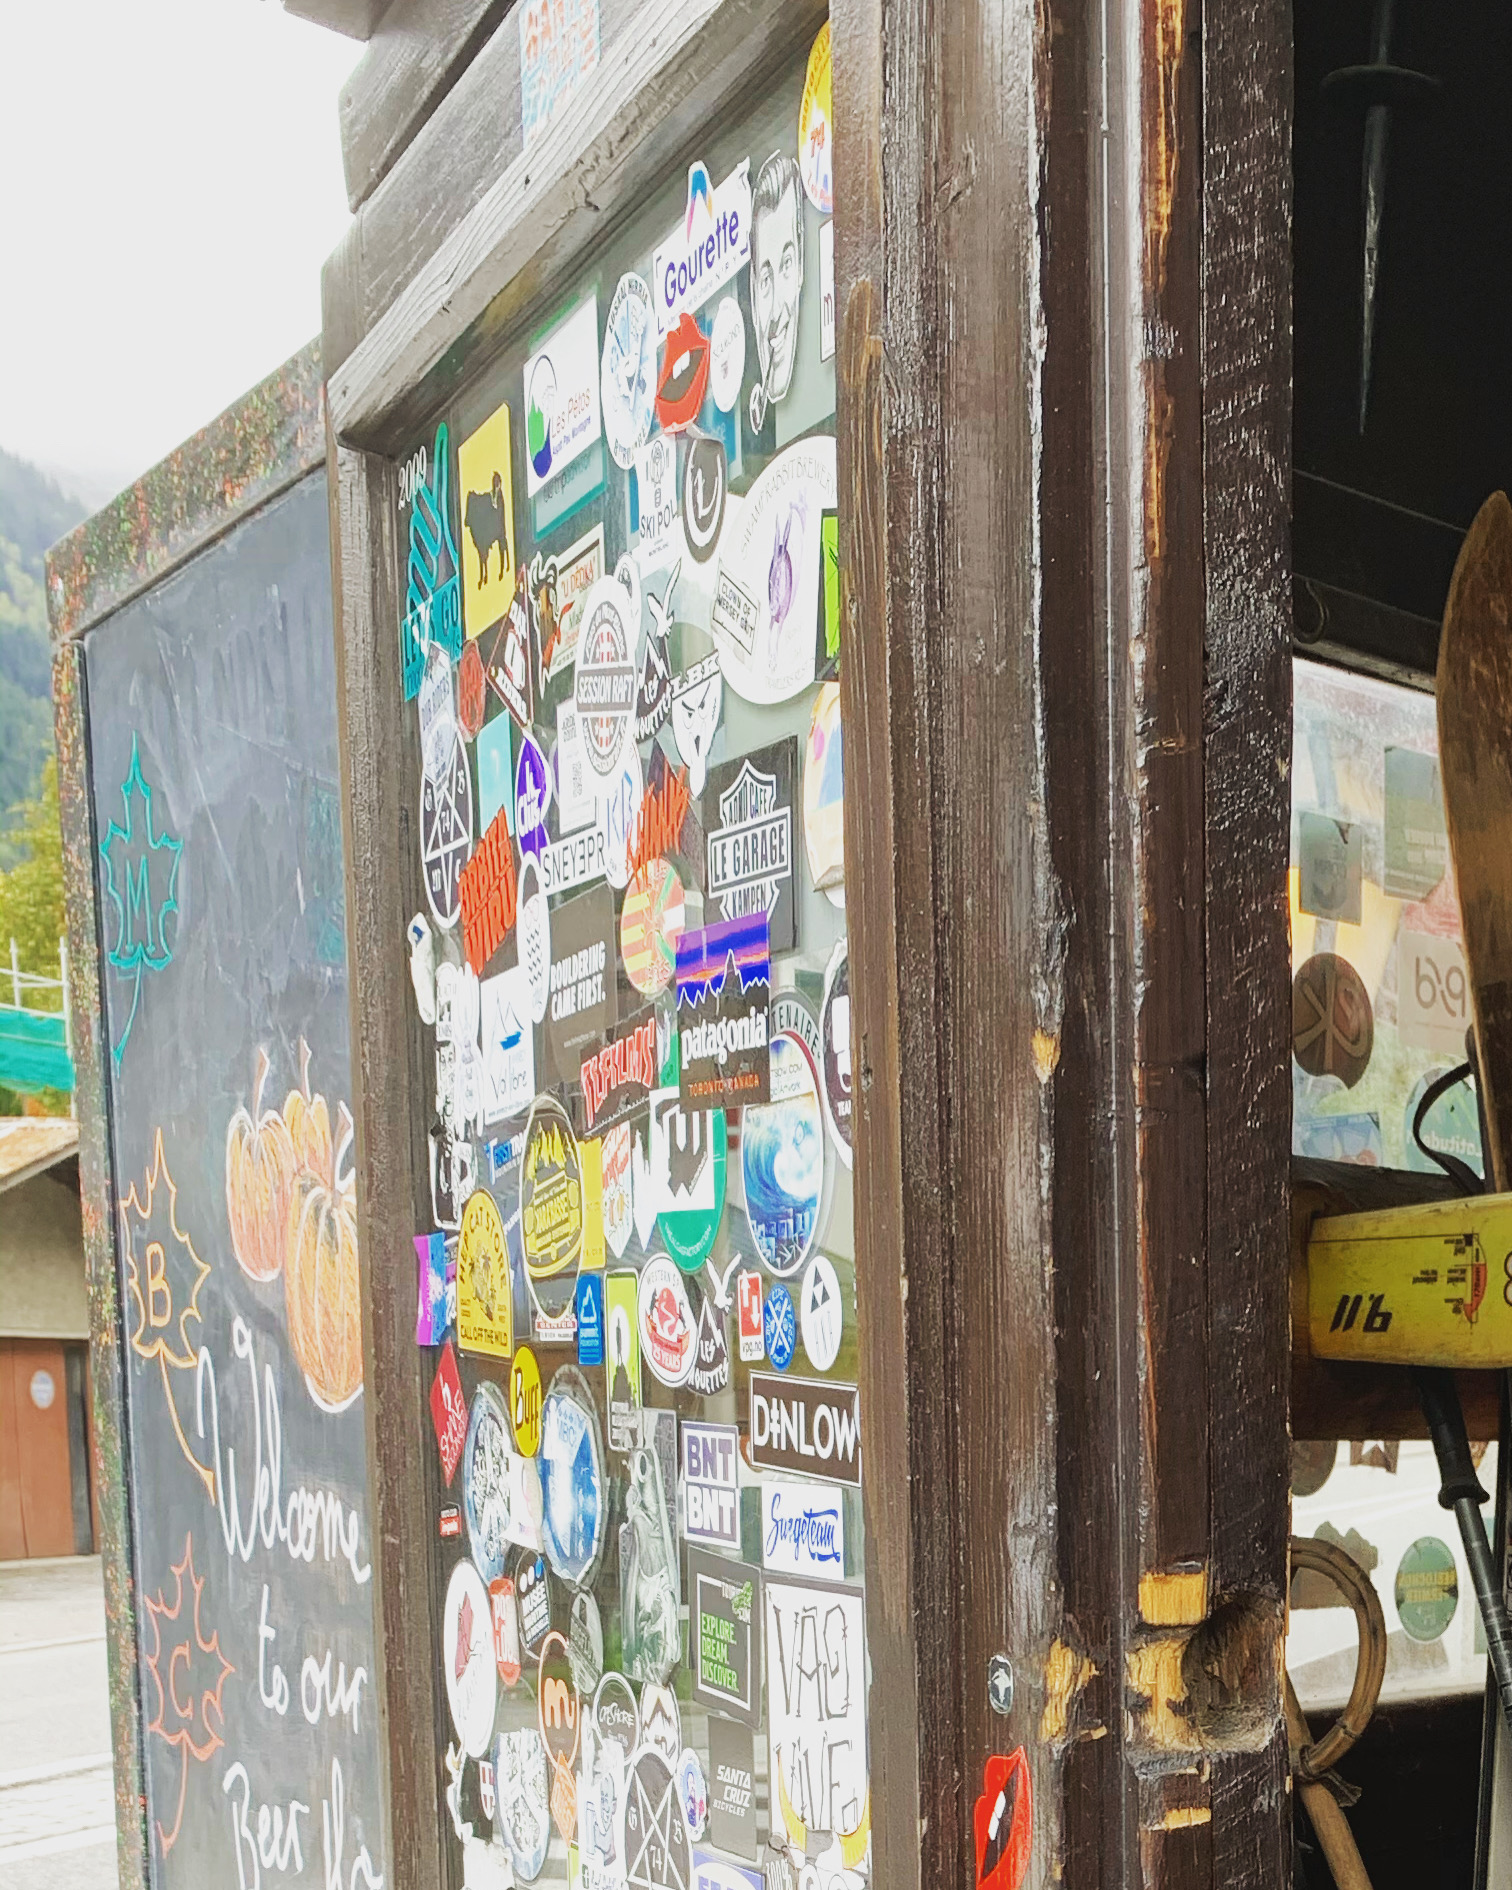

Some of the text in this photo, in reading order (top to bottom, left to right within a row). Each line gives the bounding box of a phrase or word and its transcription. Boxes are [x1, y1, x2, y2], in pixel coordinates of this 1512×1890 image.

[664, 210, 739, 308] Gourette
[640, 509, 655, 540] SKI
[578, 674, 634, 704] SESSION RAFT
[713, 823, 785, 884] LE GARAGE
[126, 855, 156, 954] M
[732, 883, 767, 919] KAMPEN
[550, 940, 606, 993] BOULDERING
[552, 975, 606, 1021] CAME FIRST.
[681, 1006, 767, 1070] patagonia
[688, 1074, 760, 1097] TORONTO CANADA
[146, 1242, 172, 1328] B
[197, 1316, 371, 1584] Welcome
[687, 1434, 732, 1482] BNT
[687, 1490, 736, 1535] BNT
[701, 1612, 737, 1644] EXPLORE.
[701, 1635, 730, 1665] DREAM.
[169, 1640, 192, 1718] C
[259, 1584, 367, 1734] to our
[701, 1659, 739, 1693] DISCOVER.
[717, 1764, 752, 1790] SANTA
[724, 1786, 750, 1808] CRUZ
[713, 1799, 746, 1817] BICYCLES
